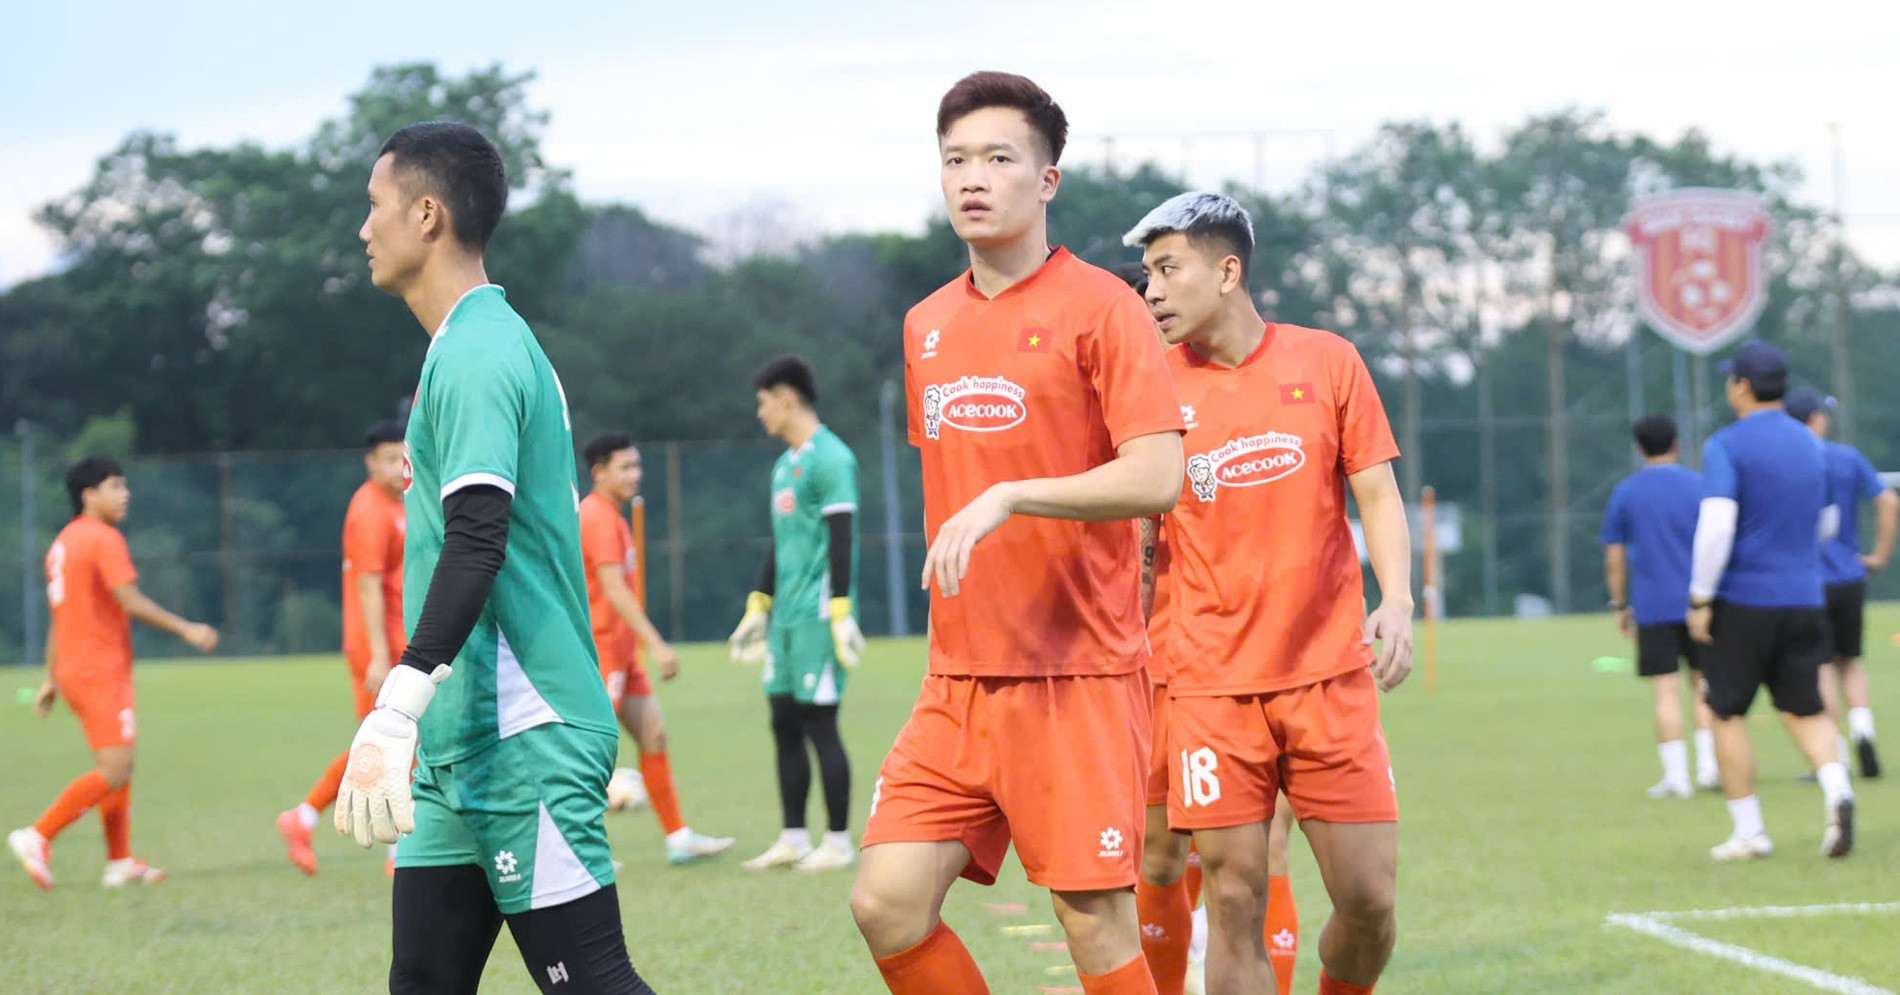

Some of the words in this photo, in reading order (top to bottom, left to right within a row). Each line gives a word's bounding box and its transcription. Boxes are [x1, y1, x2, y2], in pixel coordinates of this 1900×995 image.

[942, 379, 969, 398] Cook
[973, 378, 1023, 399] happiness
[1211, 443, 1238, 463] Cook
[1240, 434, 1300, 450] happiness
[1180, 746, 1221, 808] 18
